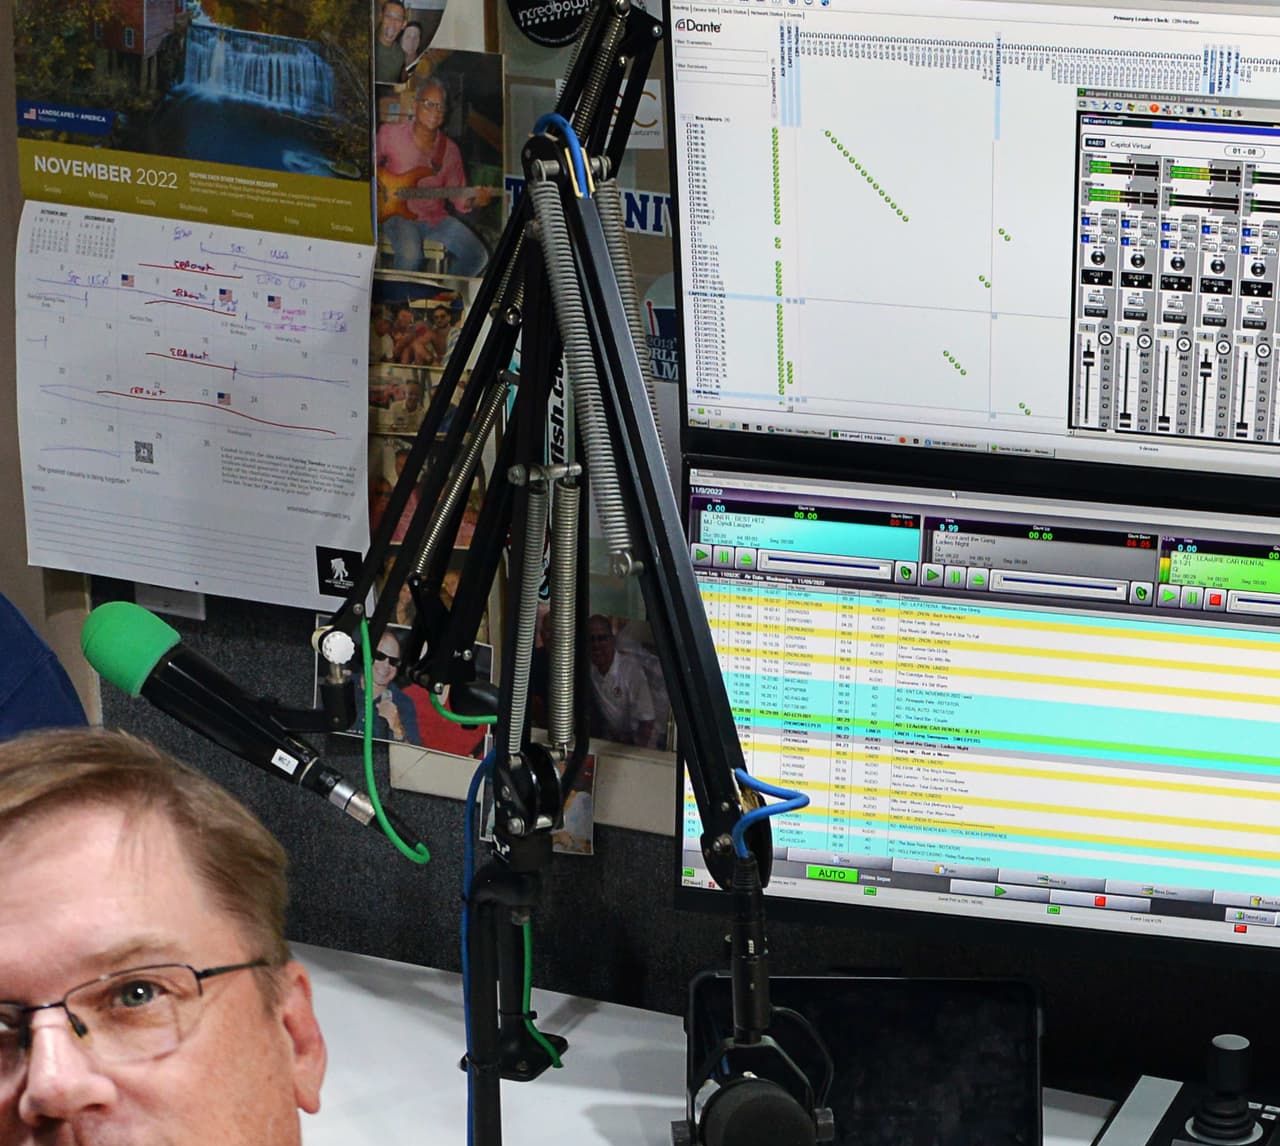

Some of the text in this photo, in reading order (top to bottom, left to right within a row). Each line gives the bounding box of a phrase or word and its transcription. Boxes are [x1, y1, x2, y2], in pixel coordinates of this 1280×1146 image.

[687, 19, 721, 33] Dante
[1110, 141, 1152, 150] Capitol Virtual
[34, 155, 178, 189] NOVEMBER 2022
[179, 203, 208, 214] Wednesday
[818, 869, 846, 880] AUTO
